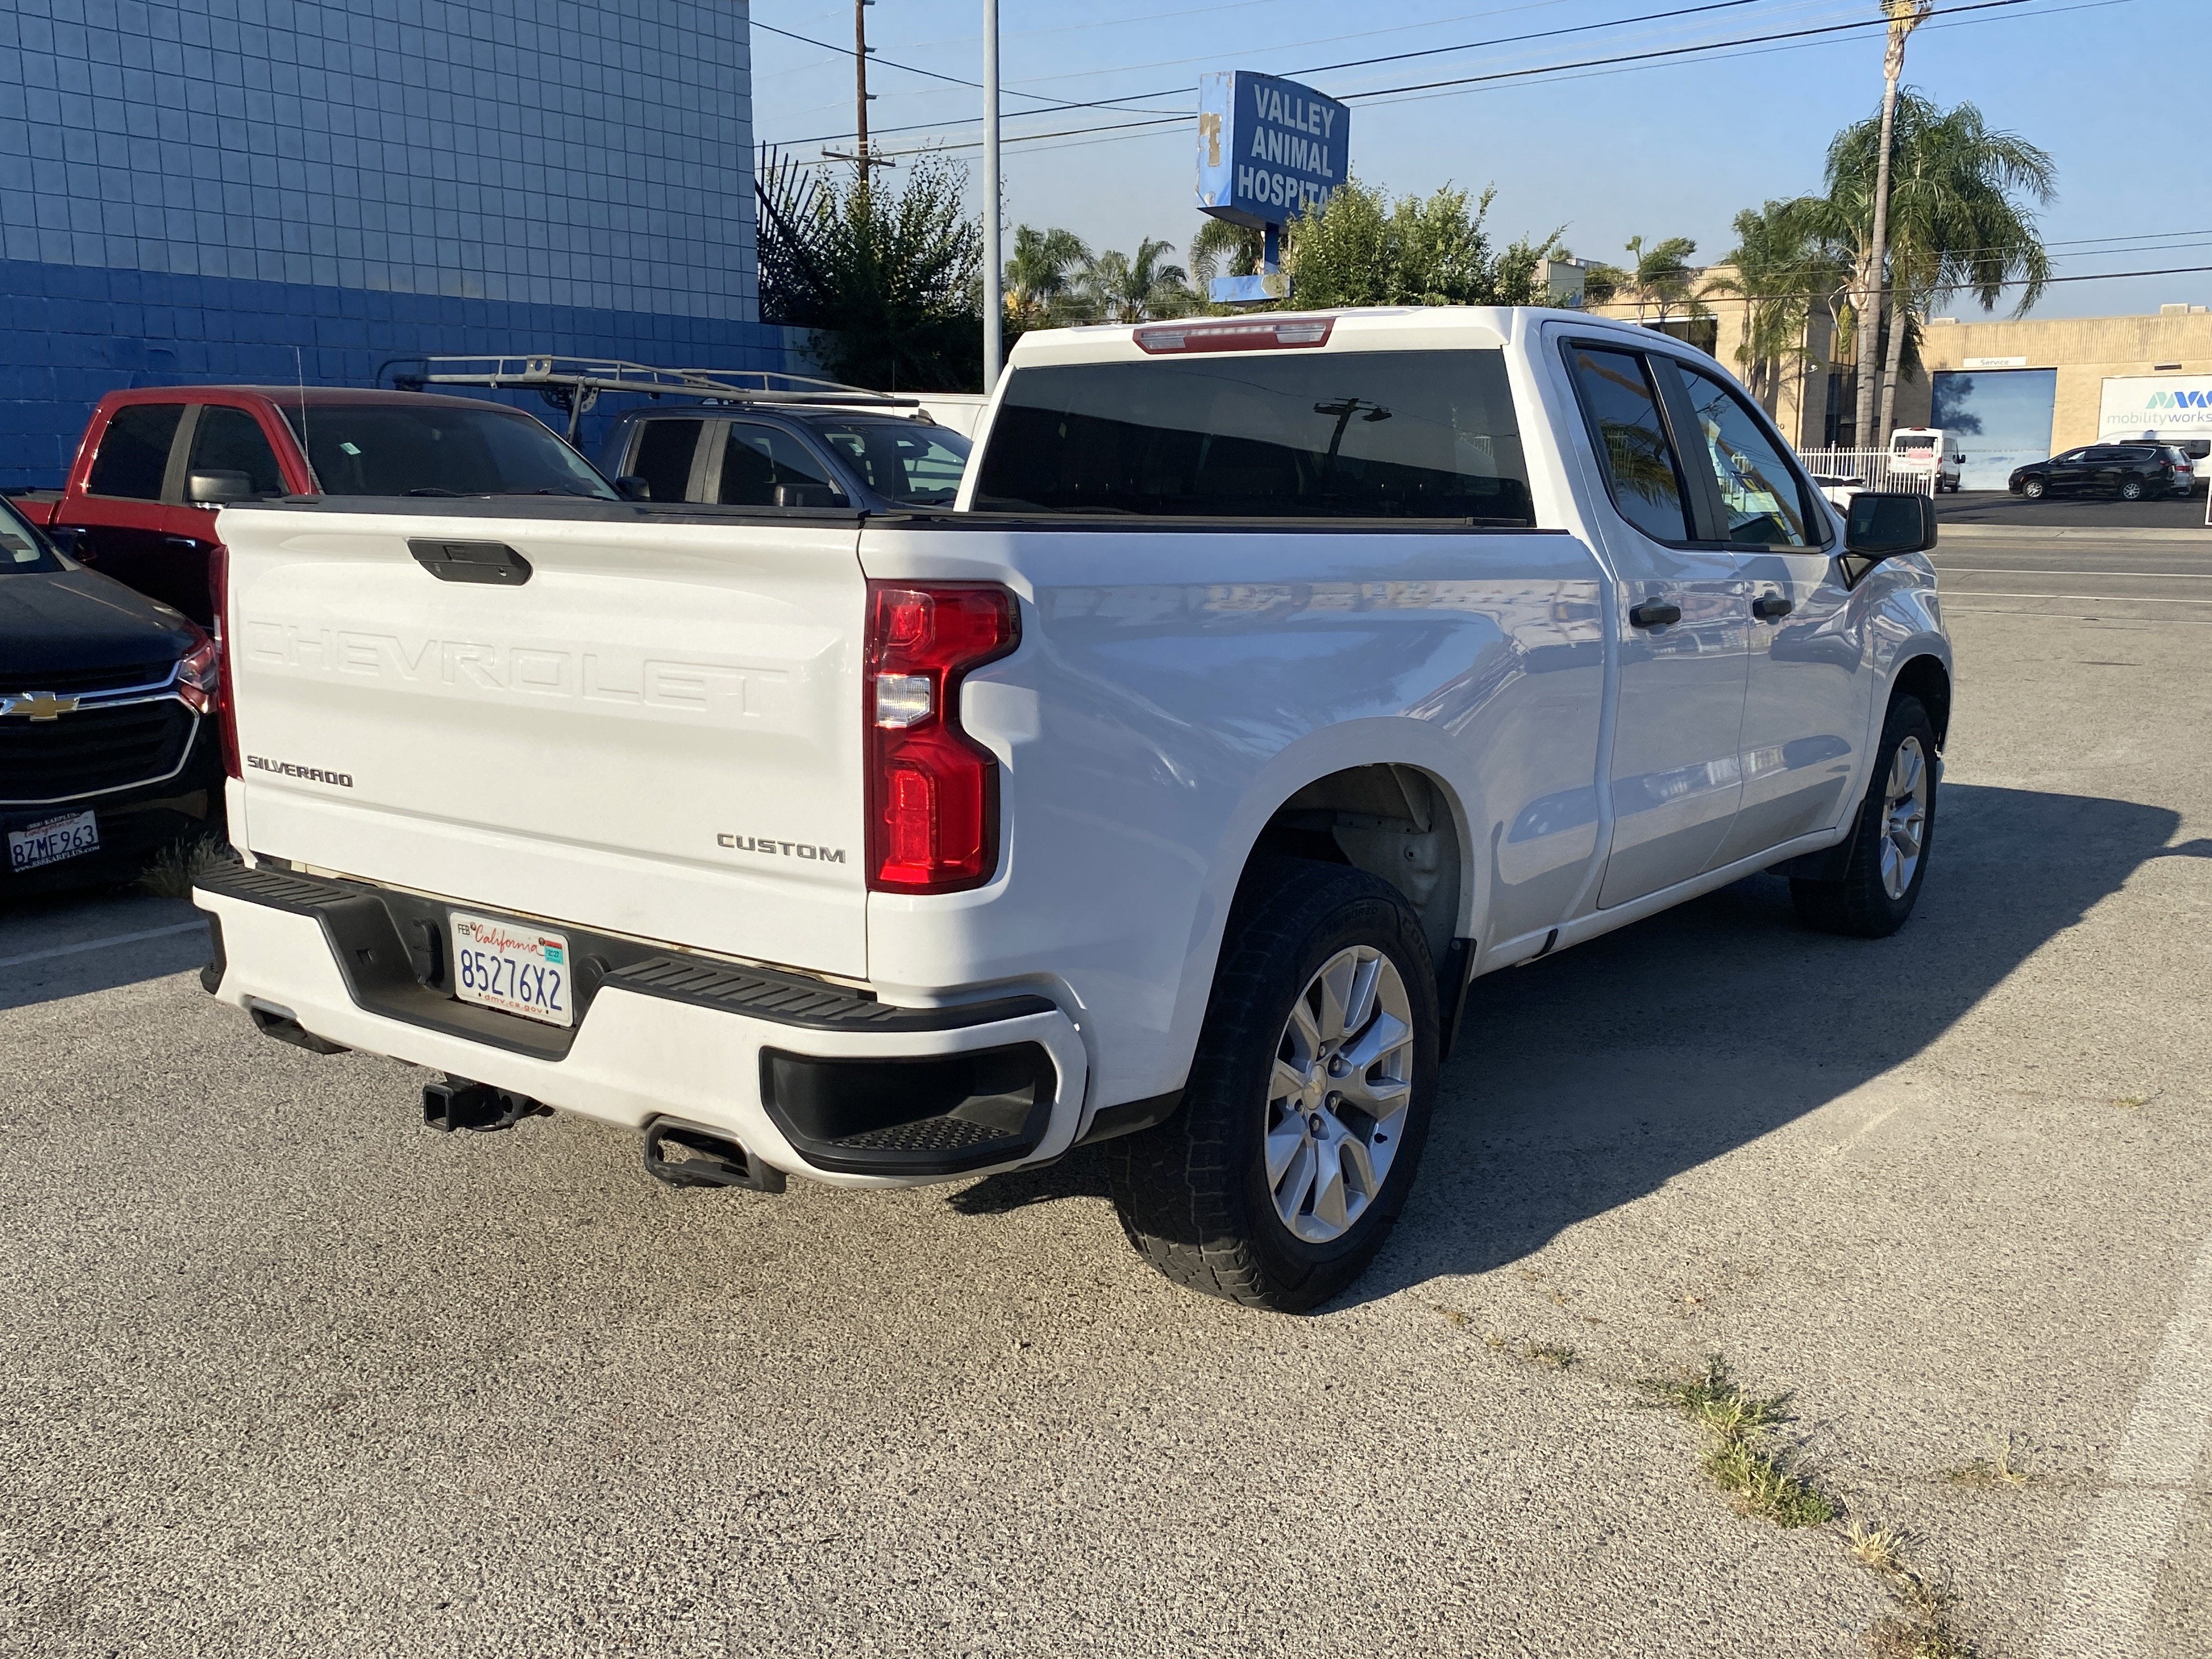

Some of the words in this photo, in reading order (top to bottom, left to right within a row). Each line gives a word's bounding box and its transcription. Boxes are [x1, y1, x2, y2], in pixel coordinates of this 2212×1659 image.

[1254, 83, 1335, 139] VALLEY
[1251, 126, 1333, 178] ANIMAL
[1238, 164, 1335, 215] HOSPITA
[2107, 411, 2212, 426] mobilityworks
[247, 620, 790, 718] CHEVROLET
[247, 754, 354, 788] SILVERADO
[13, 825, 95, 865] 8ZMF963
[717, 832, 847, 864] CUSTOM
[458, 923, 470, 935] FEB
[475, 924, 545, 956] California
[461, 949, 562, 1011] 85276X2
[484, 994, 543, 1013] dmv.ca.gov
